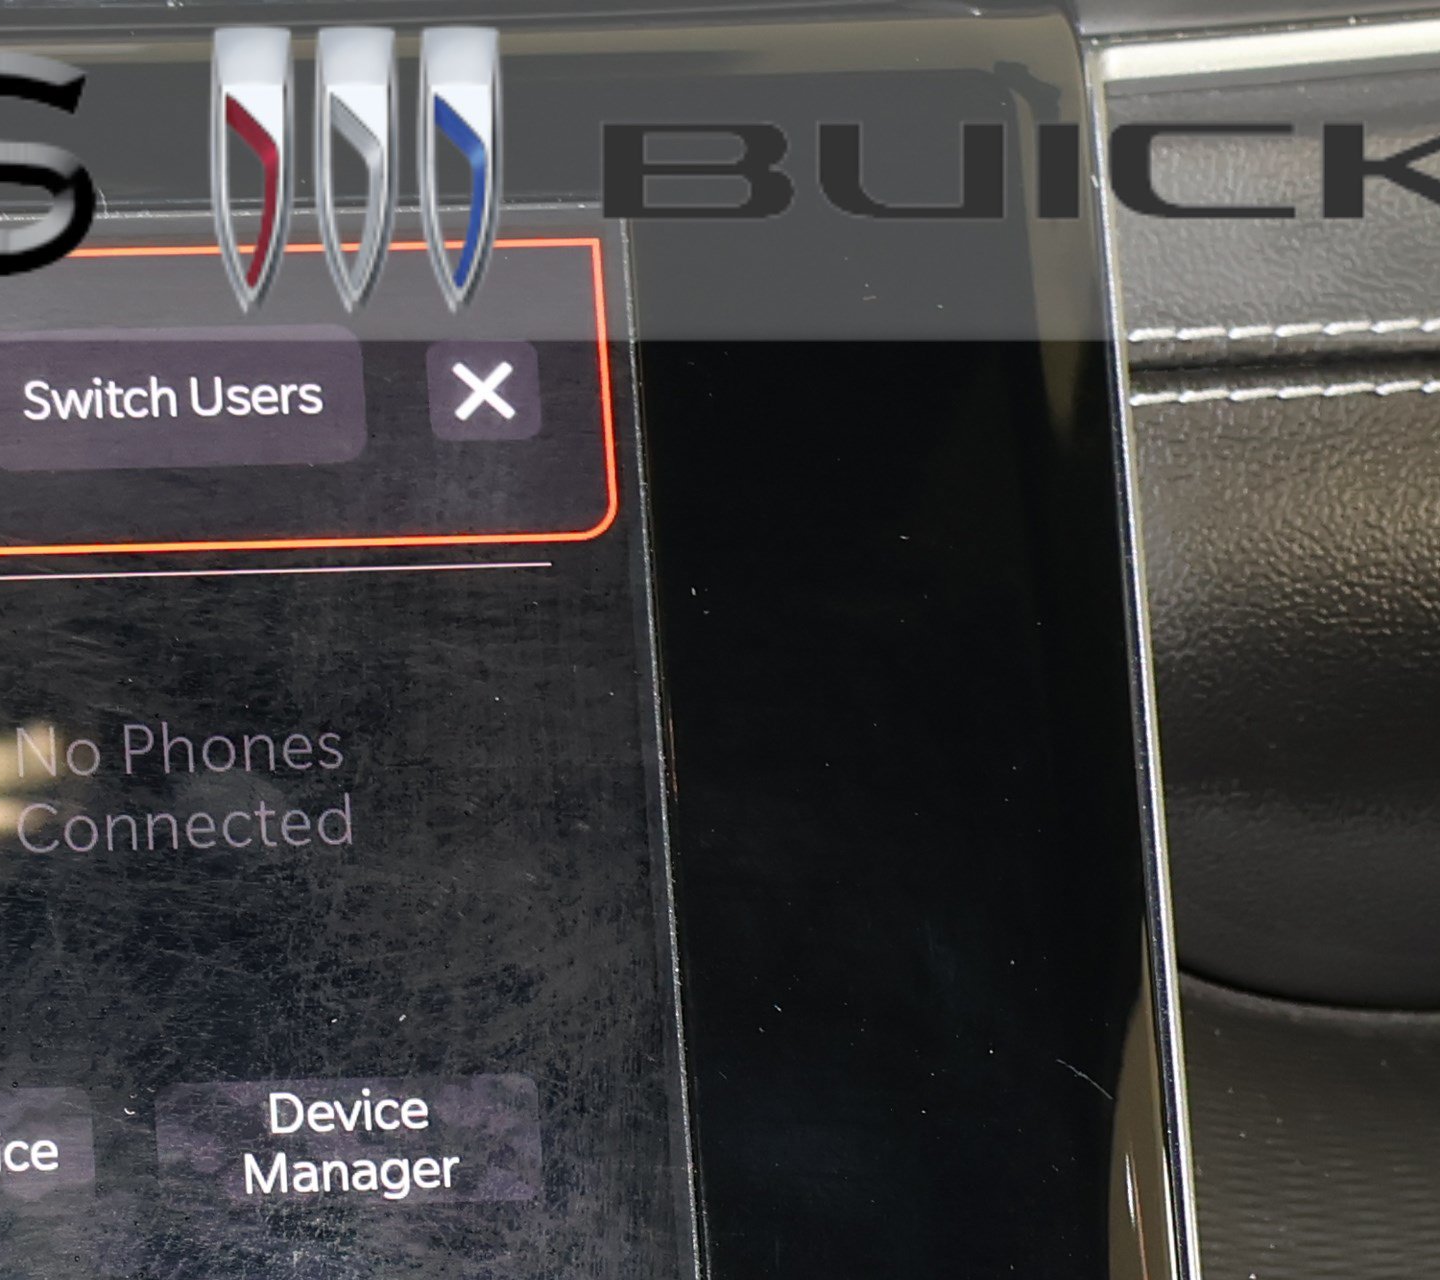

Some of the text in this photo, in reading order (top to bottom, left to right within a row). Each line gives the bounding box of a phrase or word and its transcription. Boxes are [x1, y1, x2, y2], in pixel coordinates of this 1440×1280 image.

[23, 375, 323, 421] Switch Users
[14, 721, 344, 780] No Phones
[16, 794, 353, 854] Connected
[269, 1087, 429, 1134] Device
[244, 1152, 460, 1200] Manager
